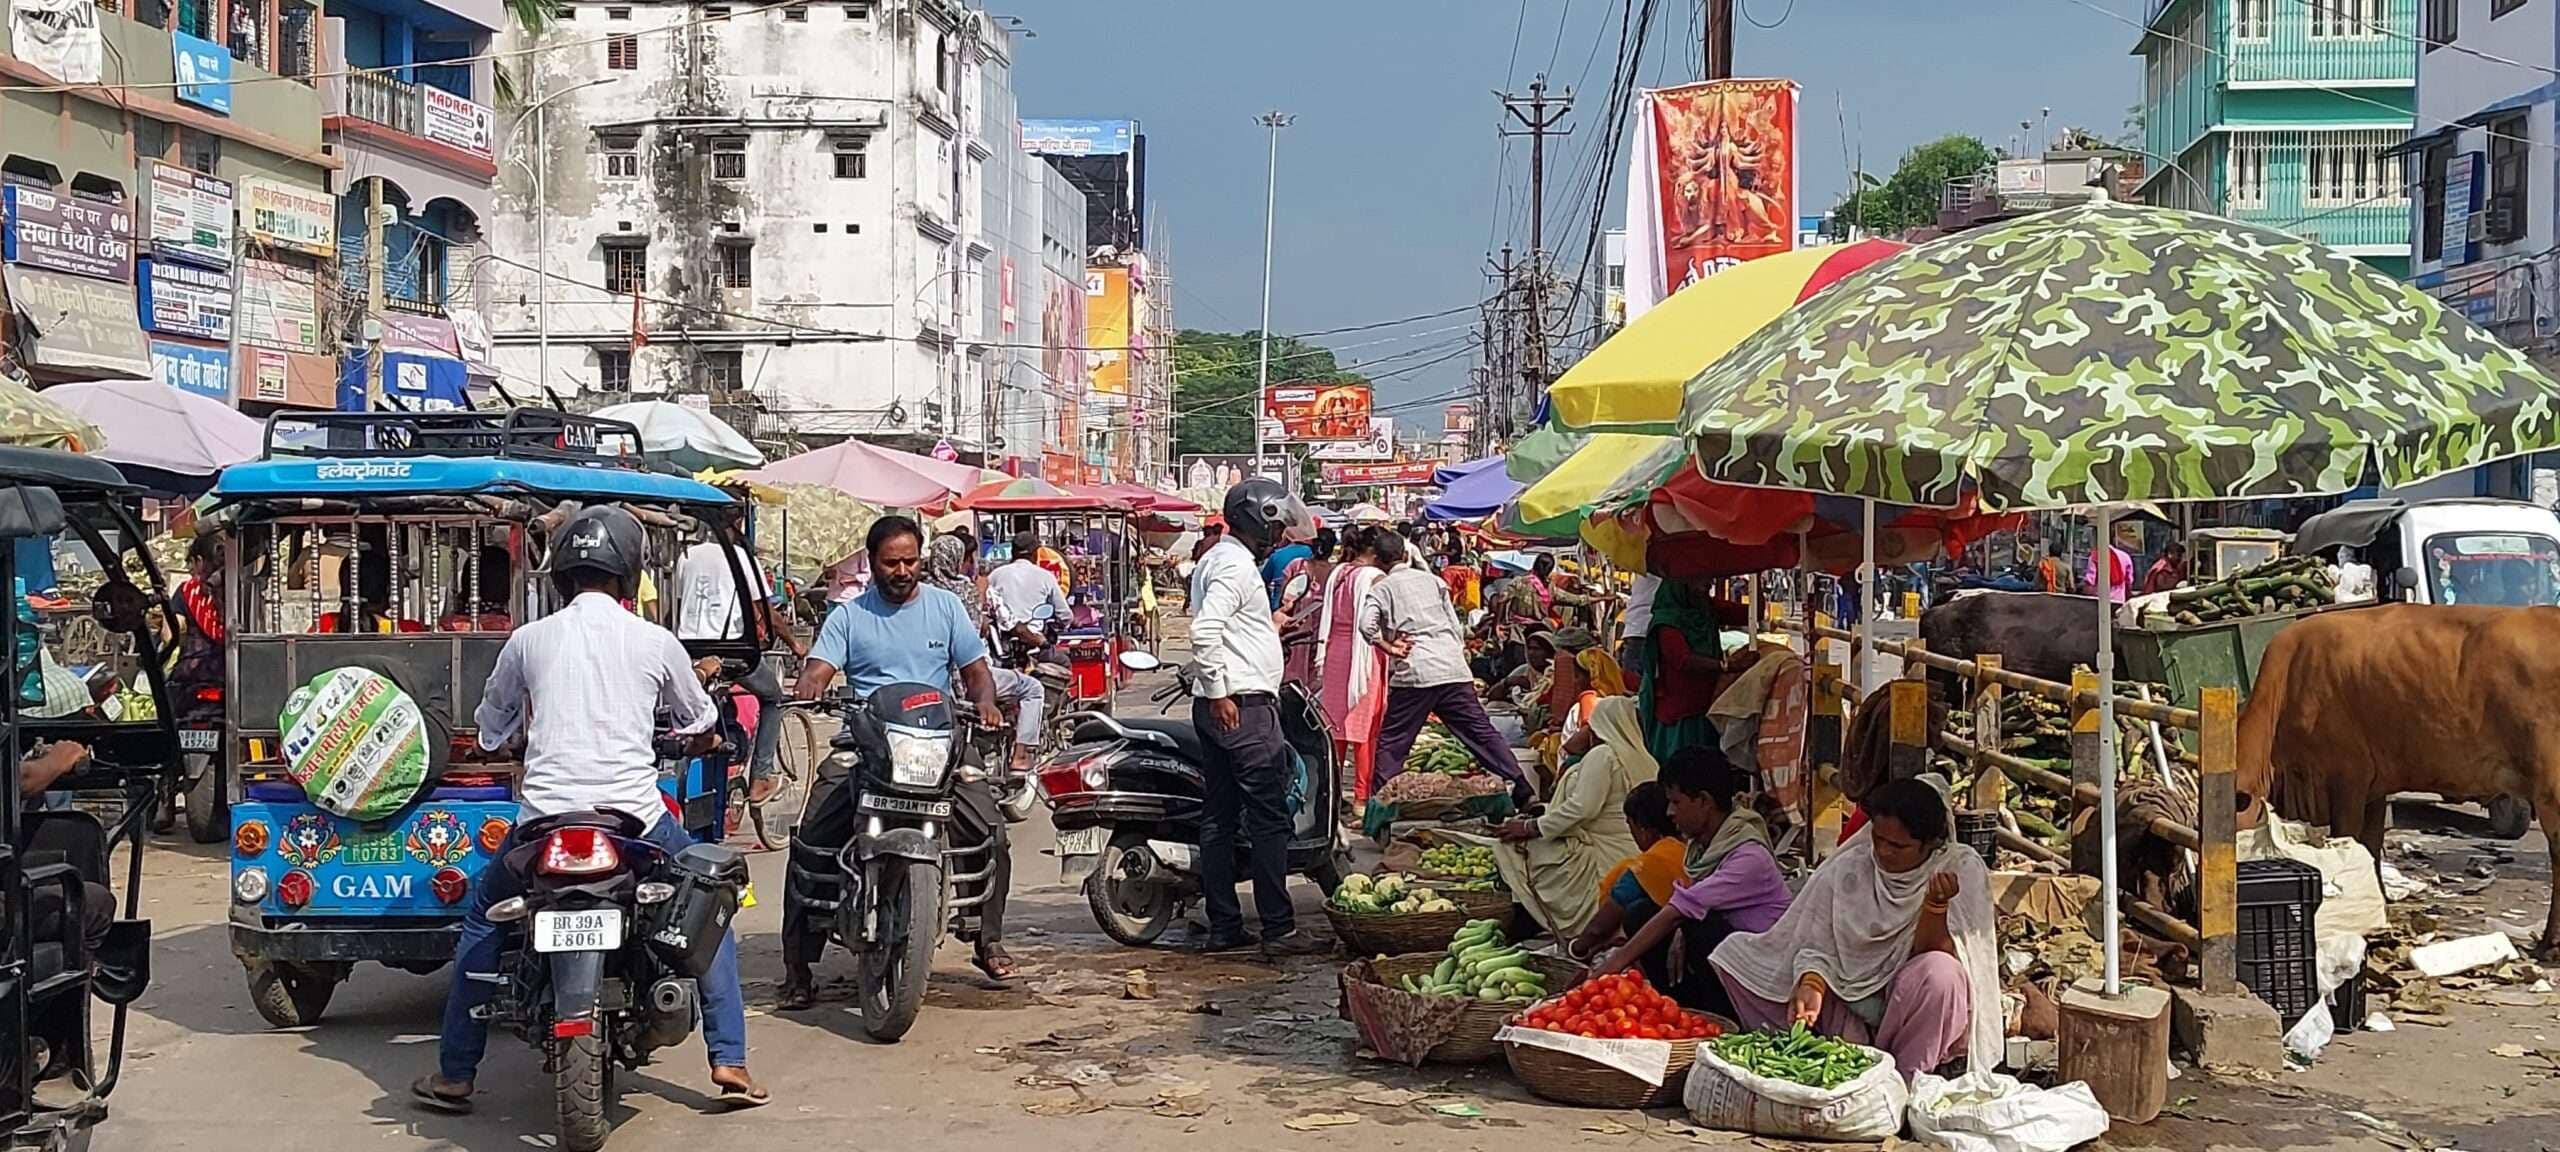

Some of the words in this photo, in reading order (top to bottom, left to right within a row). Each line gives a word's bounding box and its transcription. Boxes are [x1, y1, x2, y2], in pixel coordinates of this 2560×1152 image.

[427, 89, 474, 117] MADRAS
[86, 209, 103, 226] घर
[20, 220, 58, 246] सबा
[60, 221, 95, 254] पैथो
[98, 230, 128, 261] लैब
[564, 424, 596, 448] GAM
[317, 461, 412, 480] इलेक्ट्रोमाउंट
[332, 874, 414, 898] GAM
[553, 916, 572, 929] BR
[575, 915, 604, 929] 39A
